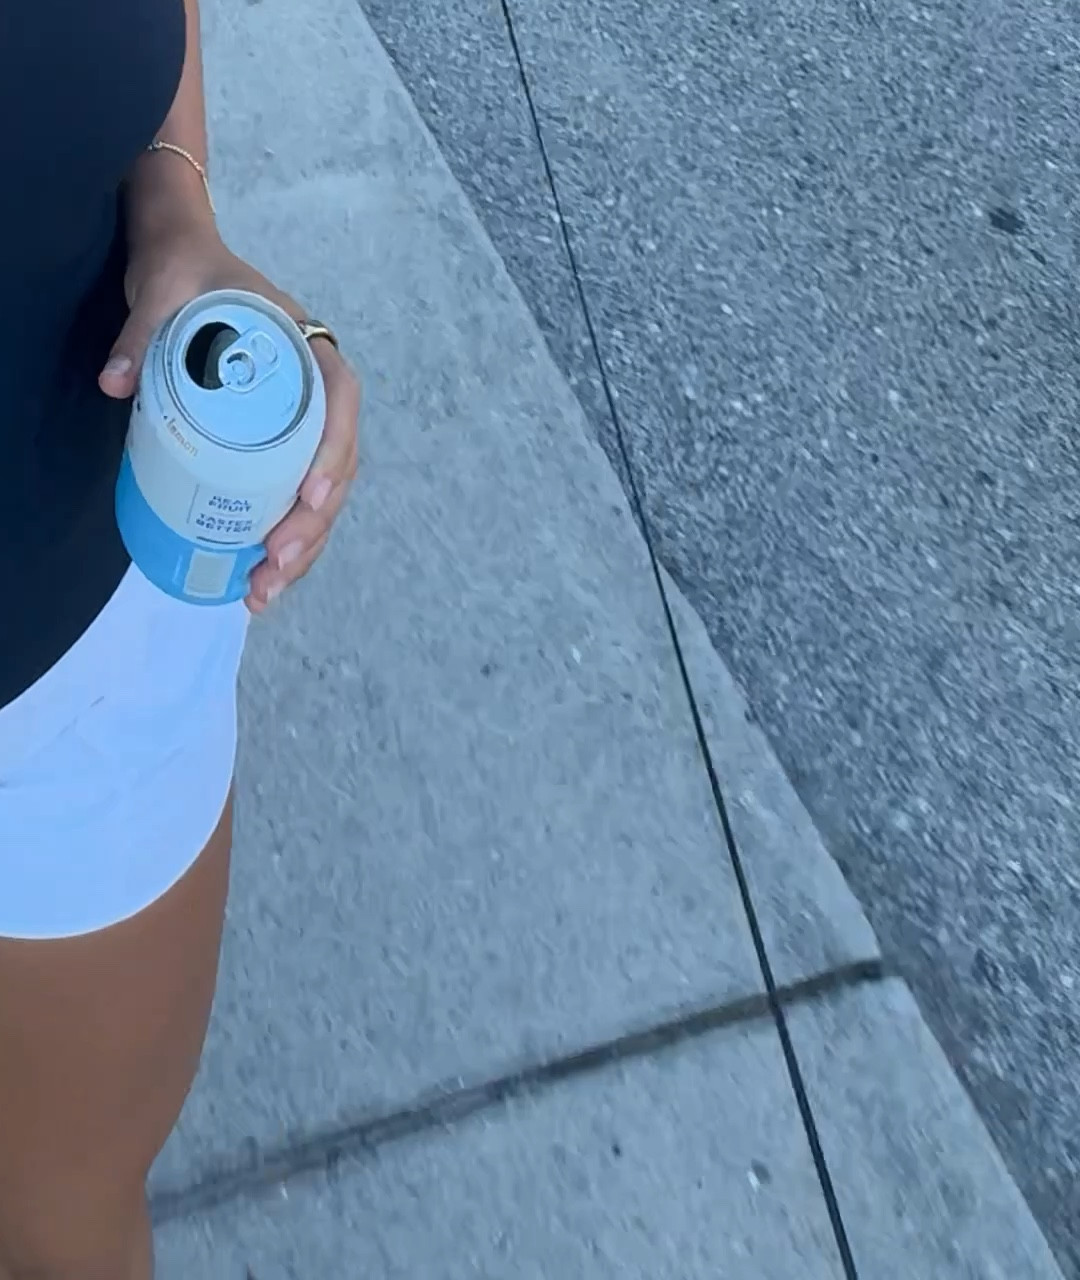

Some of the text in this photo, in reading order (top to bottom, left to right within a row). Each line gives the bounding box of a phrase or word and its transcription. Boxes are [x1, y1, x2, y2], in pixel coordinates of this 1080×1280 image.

[167, 416, 199, 458] lemon
[208, 500, 253, 513] FRUIT
[213, 495, 249, 506] REAL
[196, 518, 252, 533] BETTER
